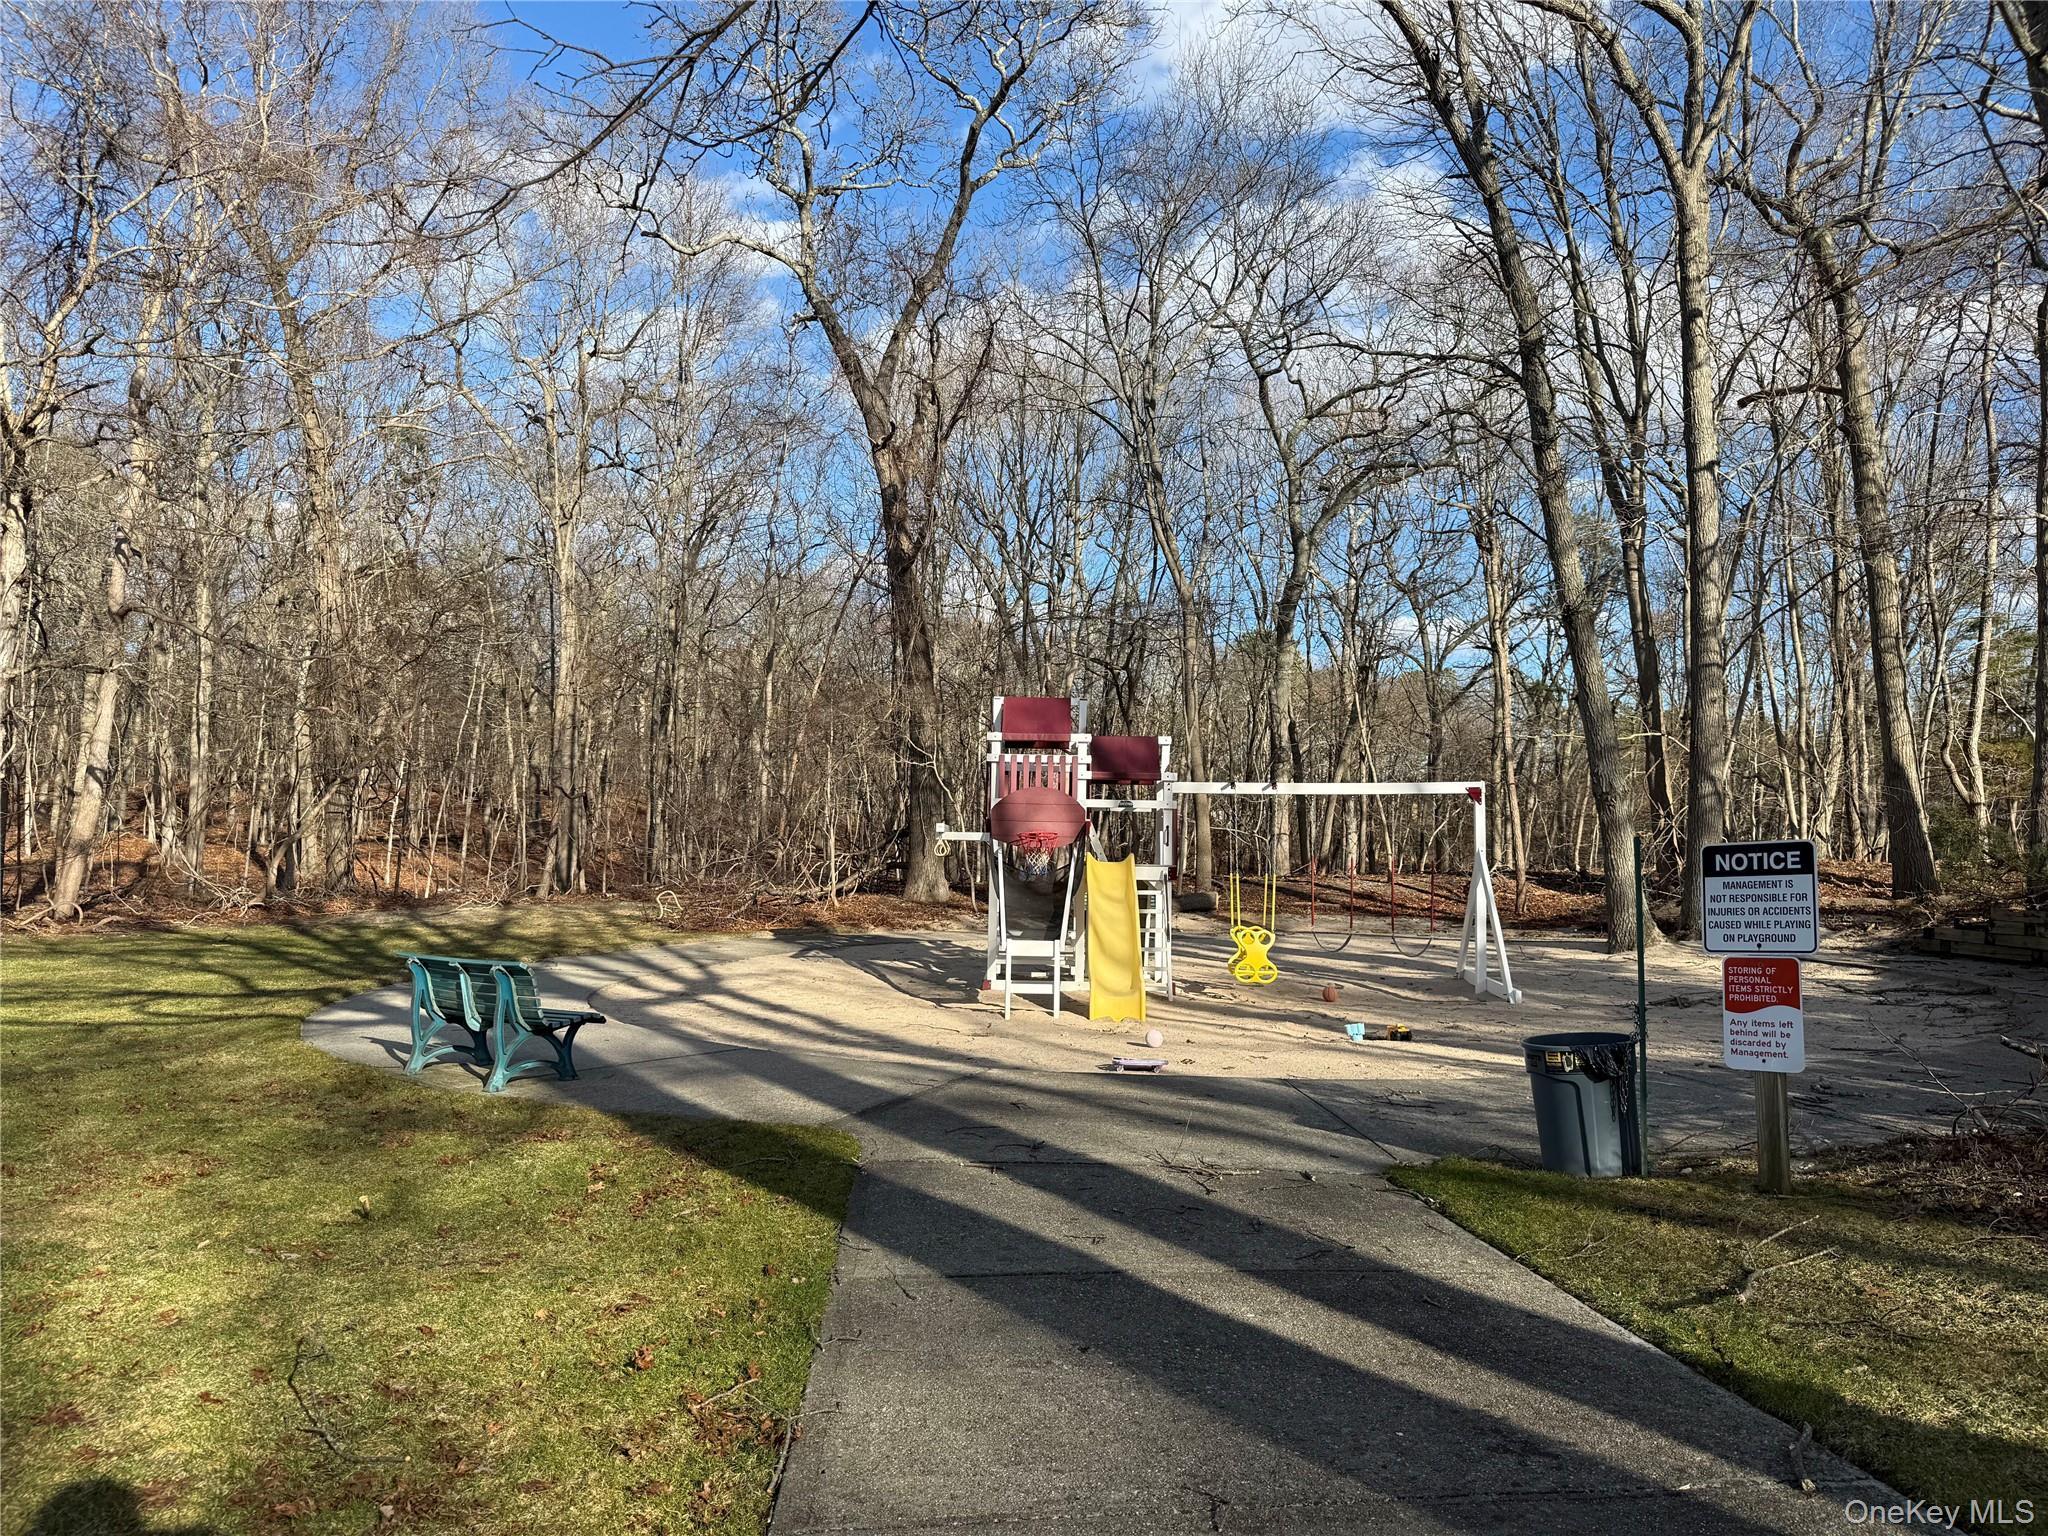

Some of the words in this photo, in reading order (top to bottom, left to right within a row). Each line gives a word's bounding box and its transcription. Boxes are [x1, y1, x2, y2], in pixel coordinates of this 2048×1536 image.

[1715, 851, 1801, 871] NOTICE
[1723, 880, 1782, 889] MANAGEMENT
[1785, 880, 1793, 888] IS
[1710, 895, 1726, 903] NOT
[1729, 894, 1787, 902] RESPONSIBLE
[1790, 893, 1807, 901] FOR
[1708, 907, 1745, 916] INJURIES
[1748, 907, 1760, 915] OR
[1763, 907, 1811, 915] ACCIDENTS
[1709, 921, 1741, 929] CAUSED
[1744, 920, 1771, 928] WHILE
[1774, 920, 1810, 928] PLAYING
[1723, 934, 1735, 942] ON
[1738, 934, 1796, 942] PLAYGROUND
[1729, 994, 1778, 1003] PROHIBITED.
[1730, 1019, 1747, 1027] Any
[1752, 1019, 1775, 1027] items
[1779, 1020, 1793, 1028] left
[1730, 1029, 1758, 1037] behind
[1731, 1039, 1771, 1047] discarded
[1776, 1041, 1786, 1049] by
[1731, 1048, 1788, 1058] Management.
